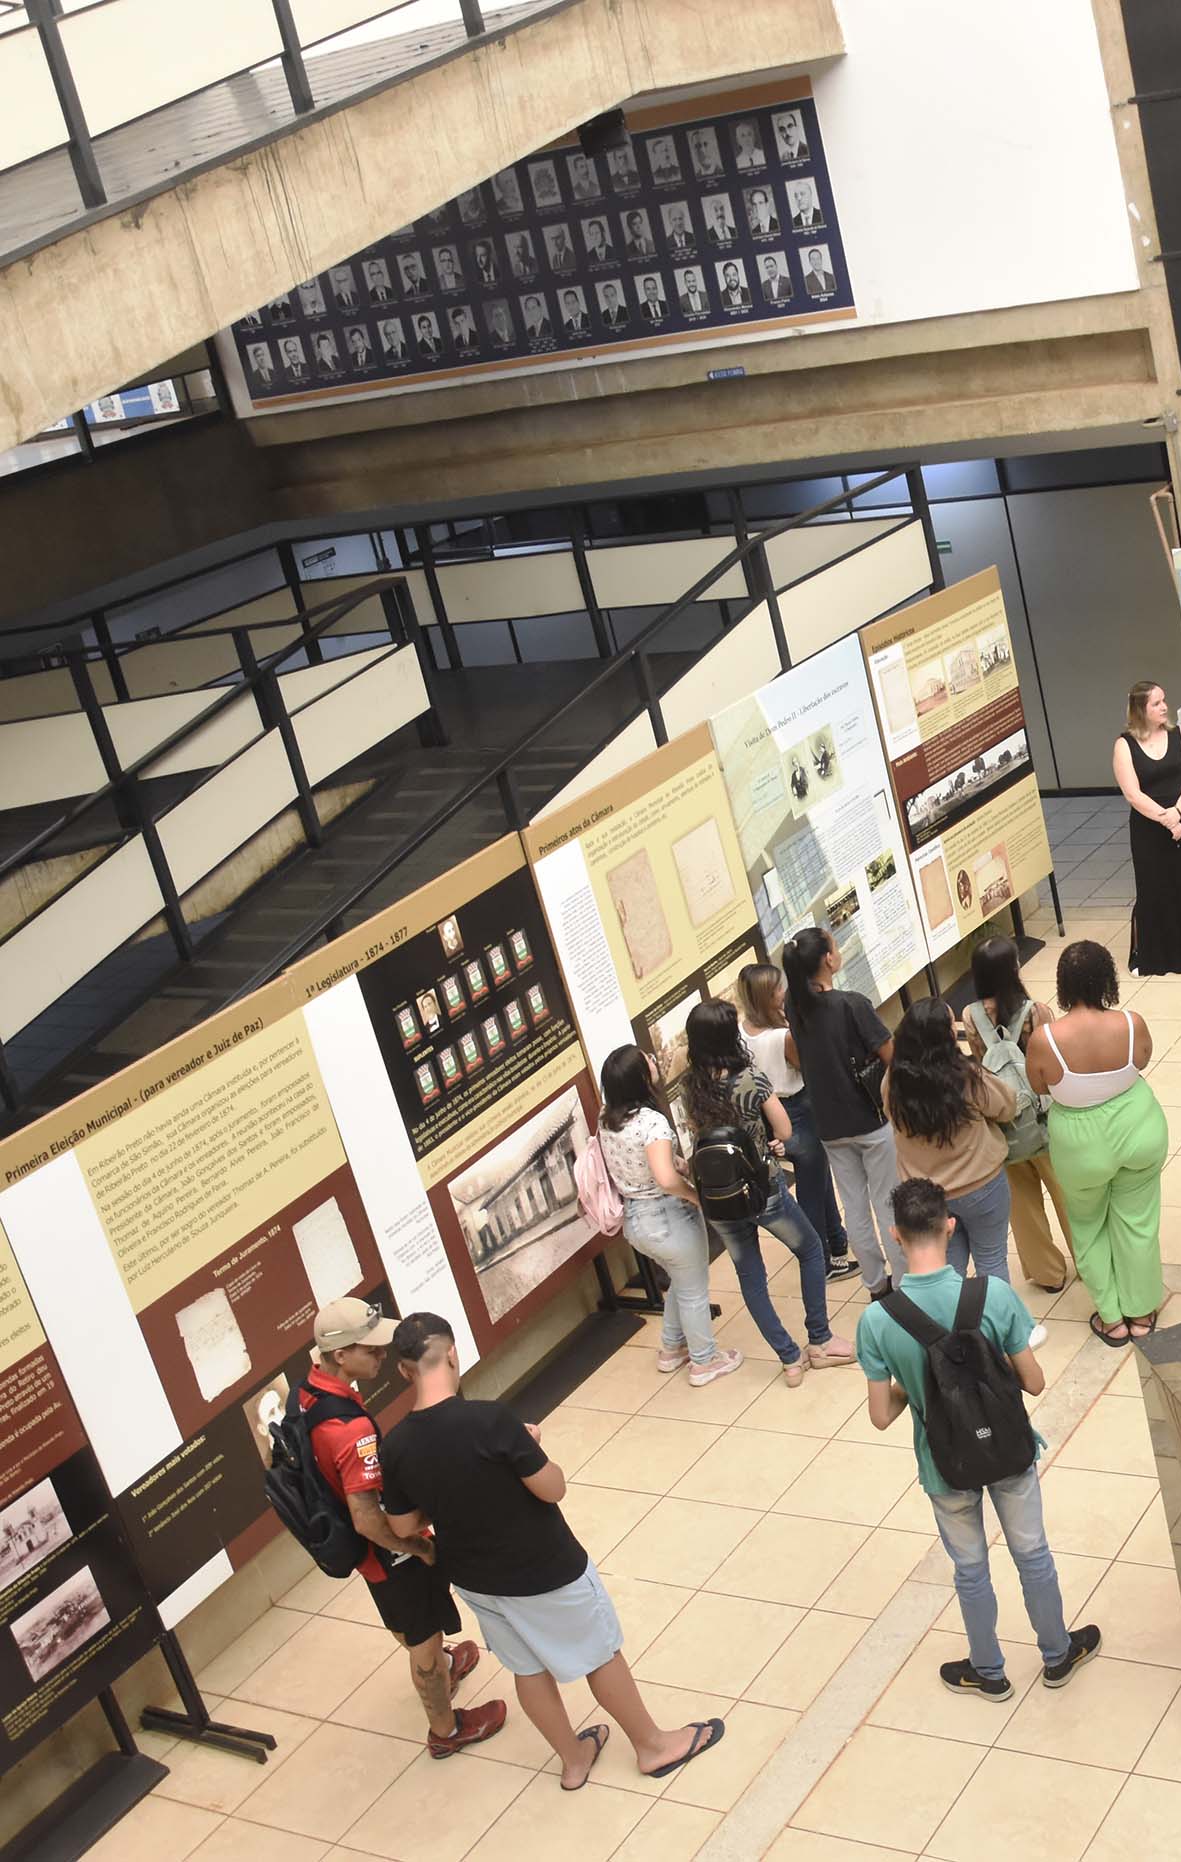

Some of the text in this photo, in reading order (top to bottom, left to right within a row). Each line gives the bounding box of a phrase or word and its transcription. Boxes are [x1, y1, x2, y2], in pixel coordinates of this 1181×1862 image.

[539, 804, 613, 855] Primeiros atos da Câmara
[316, 960, 359, 991] Legislatura
[365, 942, 384, 960] 1874
[389, 926, 409, 945] 1877
[5, 1152, 49, 1183] Primeira
[50, 1128, 85, 1155] Eleição
[86, 1098, 132, 1133] Municipal
[139, 1080, 165, 1102] (para
[166, 1055, 204, 1083] vereador
[205, 1050, 213, 1059] e
[213, 1038, 231, 1055] Juiz
[231, 1030, 243, 1043] de
[244, 1017, 263, 1035] Paz)
[91, 1166, 120, 1187] Comarca
[120, 1158, 129, 1169] de
[129, 1151, 141, 1163] São
[177, 1114, 201, 1132] Câmara
[260, 1067, 273, 1080] para
[99, 1148, 125, 1168] Ribeirão
[125, 1136, 143, 1152] Preto
[143, 1128, 155, 1141] não
[190, 1098, 203, 1111] uma
[203, 1084, 226, 1102] Câmara
[96, 1188, 104, 1199] de
[104, 1172, 131, 1192] Ribeirão
[130, 1161, 148, 1176] Preto
[159, 1147, 168, 1158] dia
[168, 1142, 176, 1152] 22
[176, 1136, 185, 1146] de
[211, 1114, 219, 1124] de
[111, 1189, 132, 1207] sessão
[132, 1181, 141, 1192] do
[141, 1175, 152, 1187] dia
[157, 1165, 165, 1176] de
[165, 1155, 183, 1172] junho
[183, 1149, 191, 1159] de
[141, 1217, 150, 1228] de
[311, 1102, 319, 1112] de
[143, 1202, 152, 1212] da
[180, 1174, 195, 1188] João
[238, 1132, 258, 1149] Santos
[150, 1184, 160, 1194] da
[160, 1169, 183, 1188] Câmara
[198, 1209, 206, 1220] do
[213, 1261, 231, 1277] Termo
[230, 1255, 238, 1265] de
[166, 1455, 181, 1470] mais
